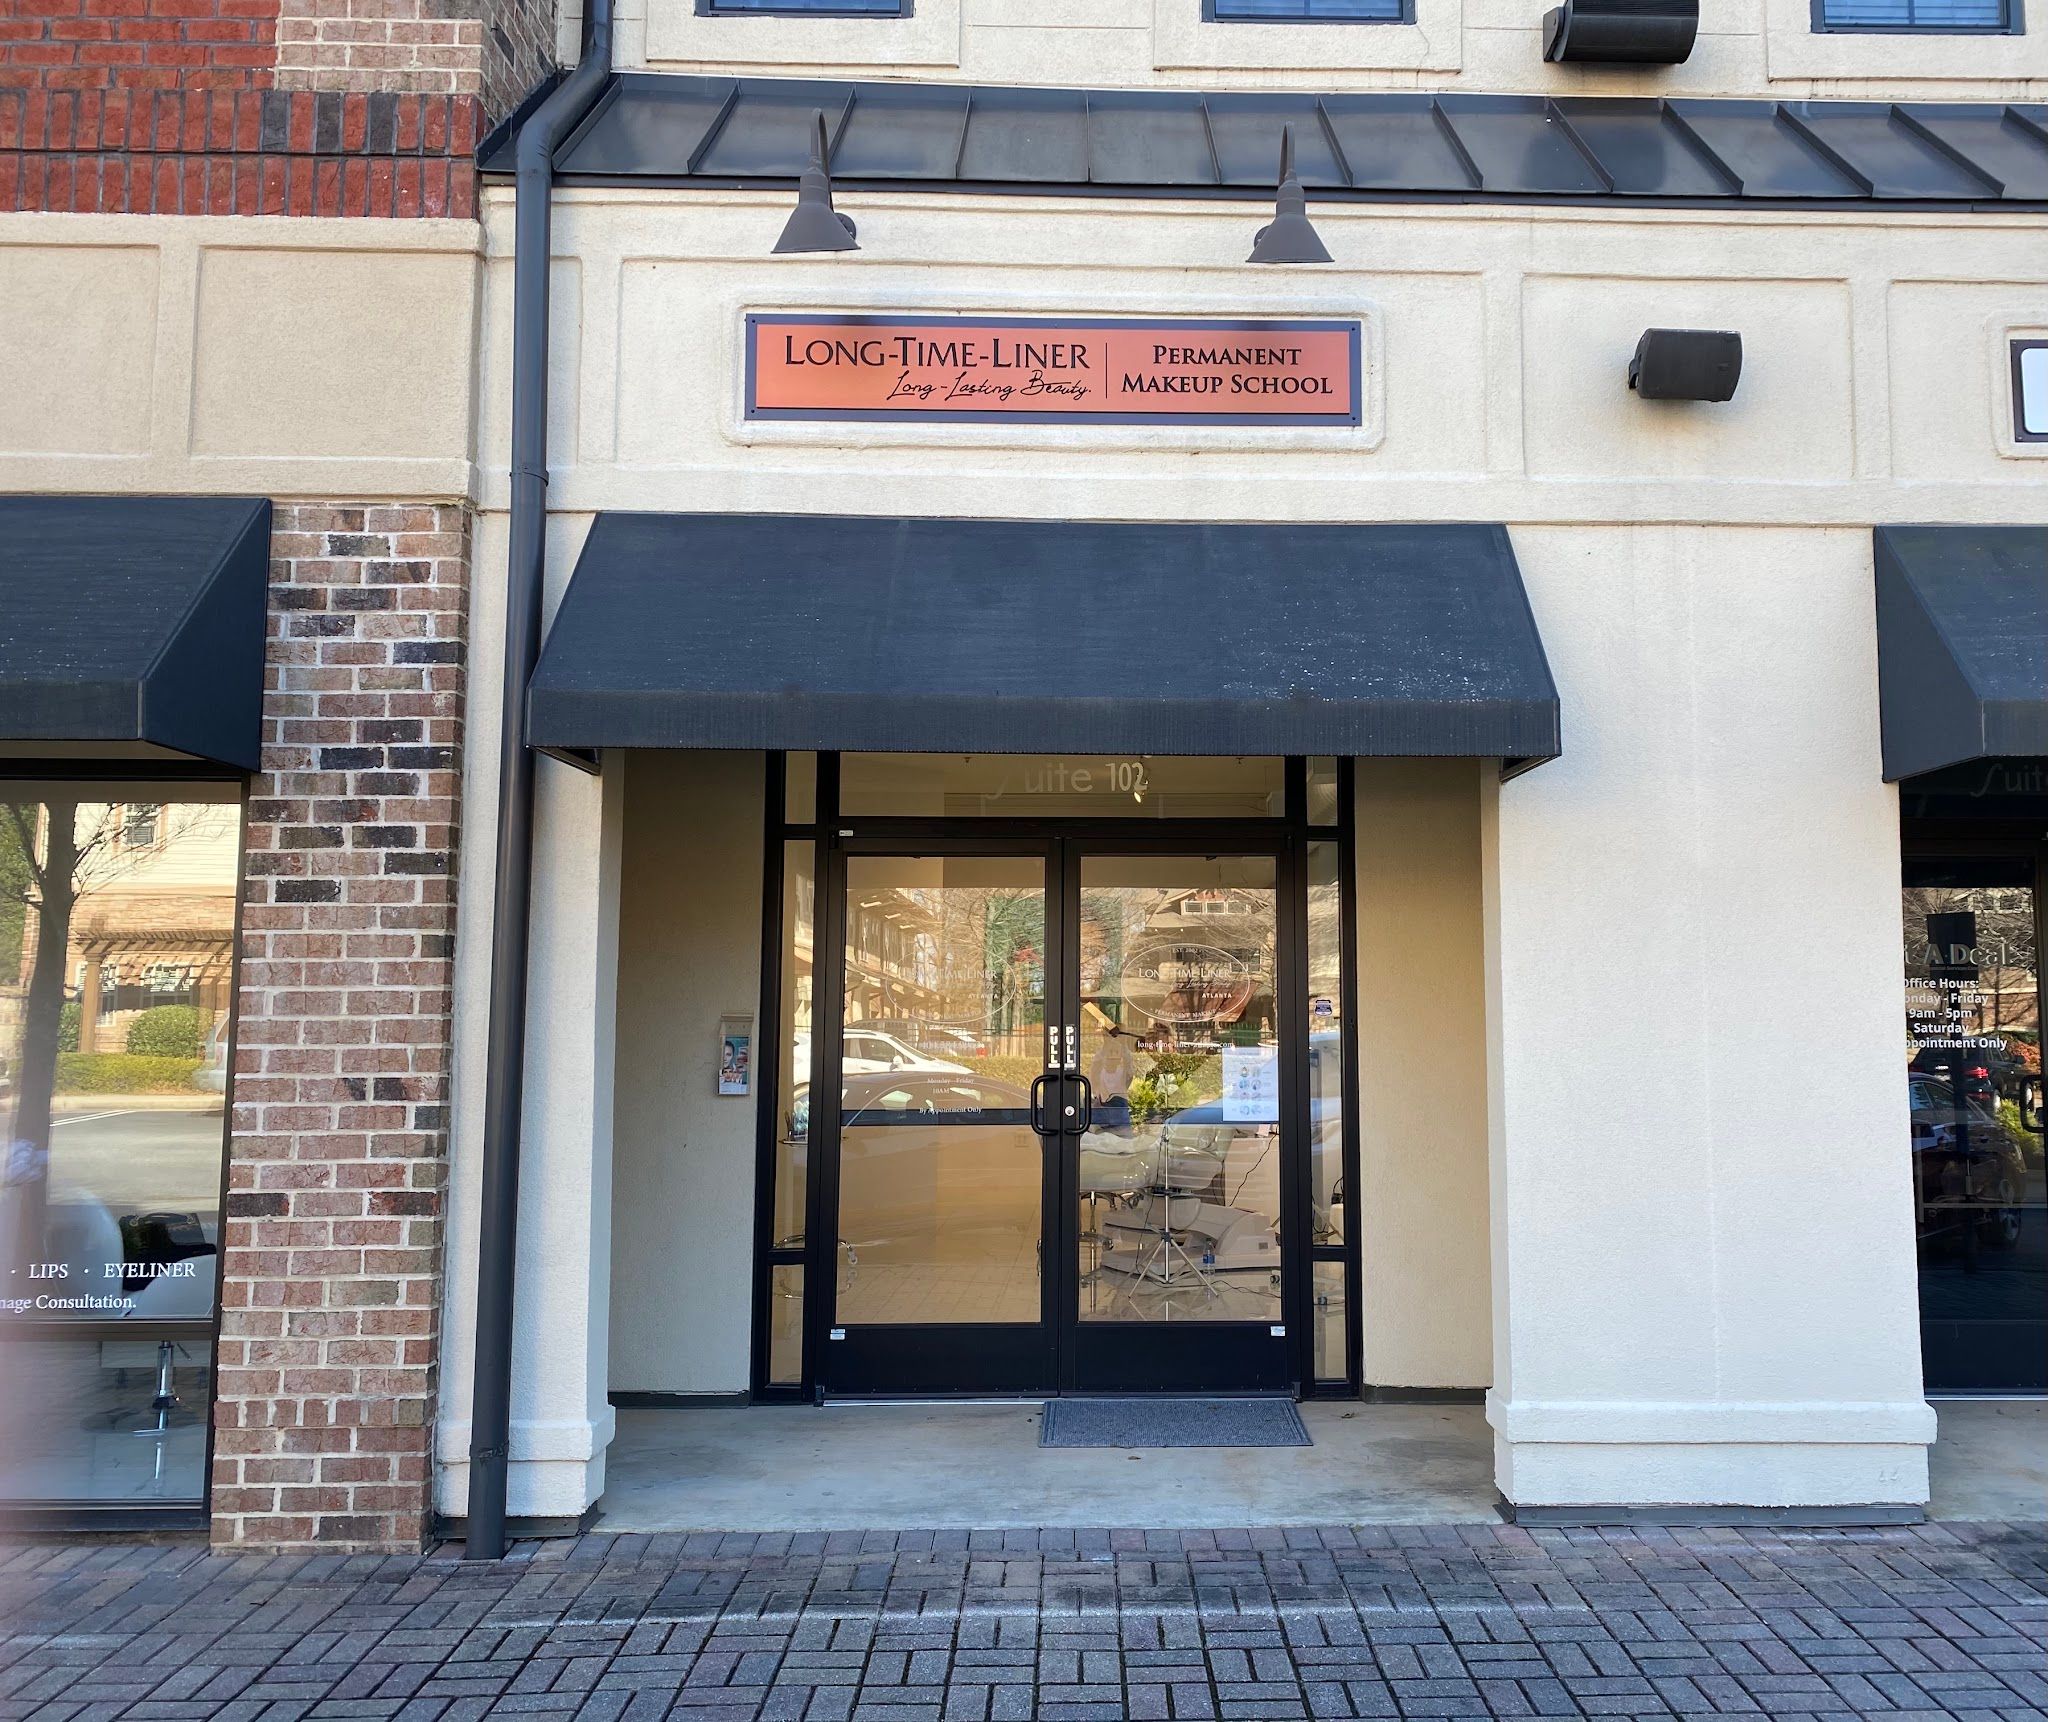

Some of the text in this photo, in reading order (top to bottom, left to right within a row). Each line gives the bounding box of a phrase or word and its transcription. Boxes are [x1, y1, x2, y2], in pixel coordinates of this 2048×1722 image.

[785, 335, 1090, 369] LONG-TIME-LINER
[1153, 345, 1302, 366] PERMANENT
[1020, 369, 1092, 400] Beauty.
[1121, 373, 1333, 394] MAKEUP SCHOOL
[1105, 762, 1148, 792] 102
[1969, 763, 2048, 798] Suit
[1939, 978, 1979, 989] Hours:
[1905, 993, 1941, 1006] onday
[1950, 993, 1989, 1006] Friday
[1909, 1008, 1936, 1019] 9am
[1946, 1008, 1973, 1021] 5pm
[1913, 1022, 1969, 1036] Saturday
[1050, 1026, 1058, 1064] PULL
[1066, 1026, 1074, 1064] PULL
[1906, 1037, 2008, 1051] ppointment Only
[919, 1107, 926, 1115] By
[967, 1106, 982, 1114] Only
[28, 1262, 196, 1279] LIPS EYELINER
[0, 1294, 137, 1314] age Consultation.
